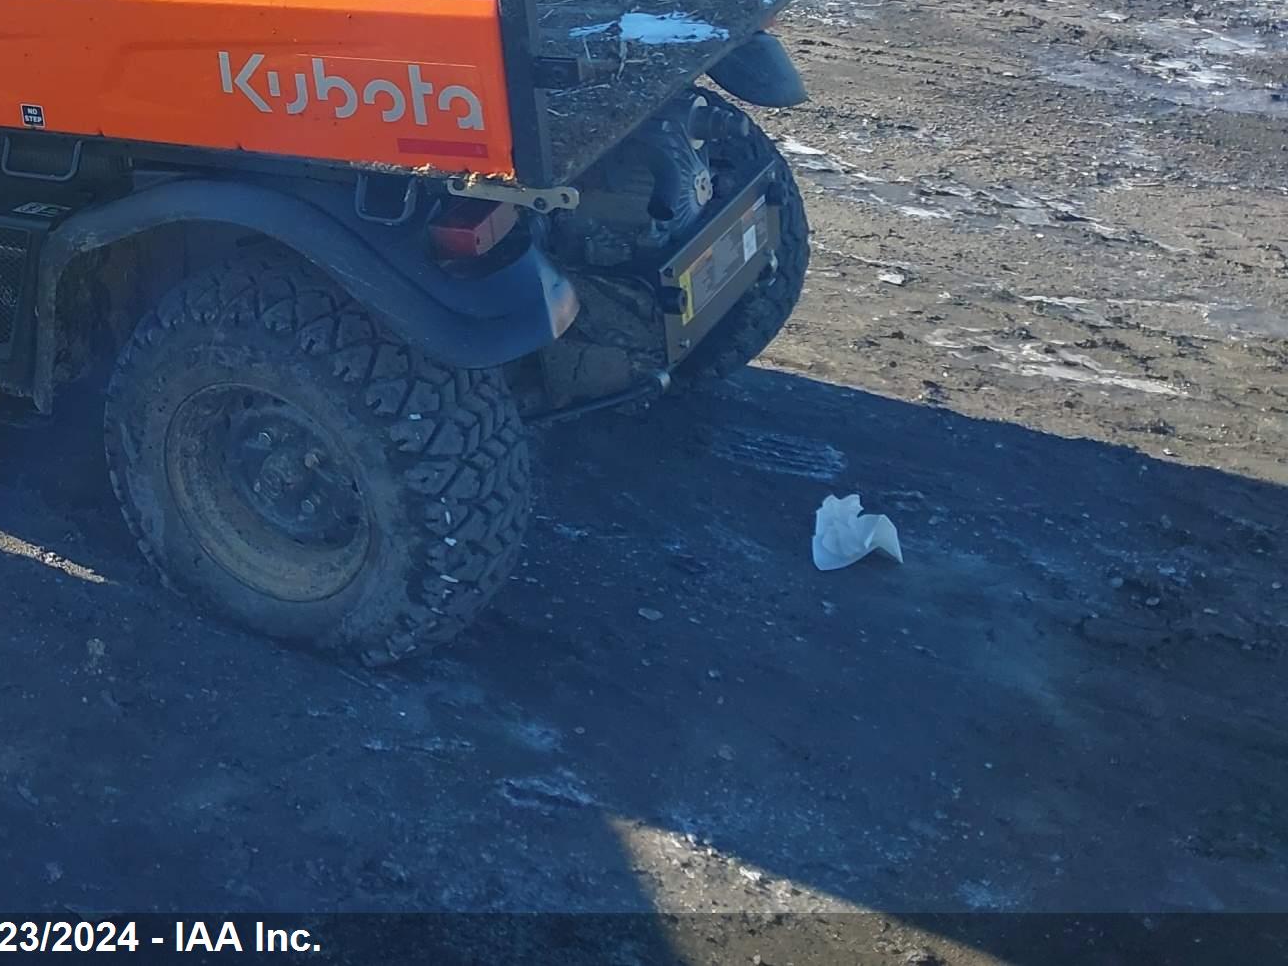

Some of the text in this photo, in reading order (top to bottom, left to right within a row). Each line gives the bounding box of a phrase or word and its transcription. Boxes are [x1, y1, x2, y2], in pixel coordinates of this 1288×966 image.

[218, 51, 485, 130] Kubota
[27, 107, 38, 115] NO
[24, 114, 42, 123] STEP
